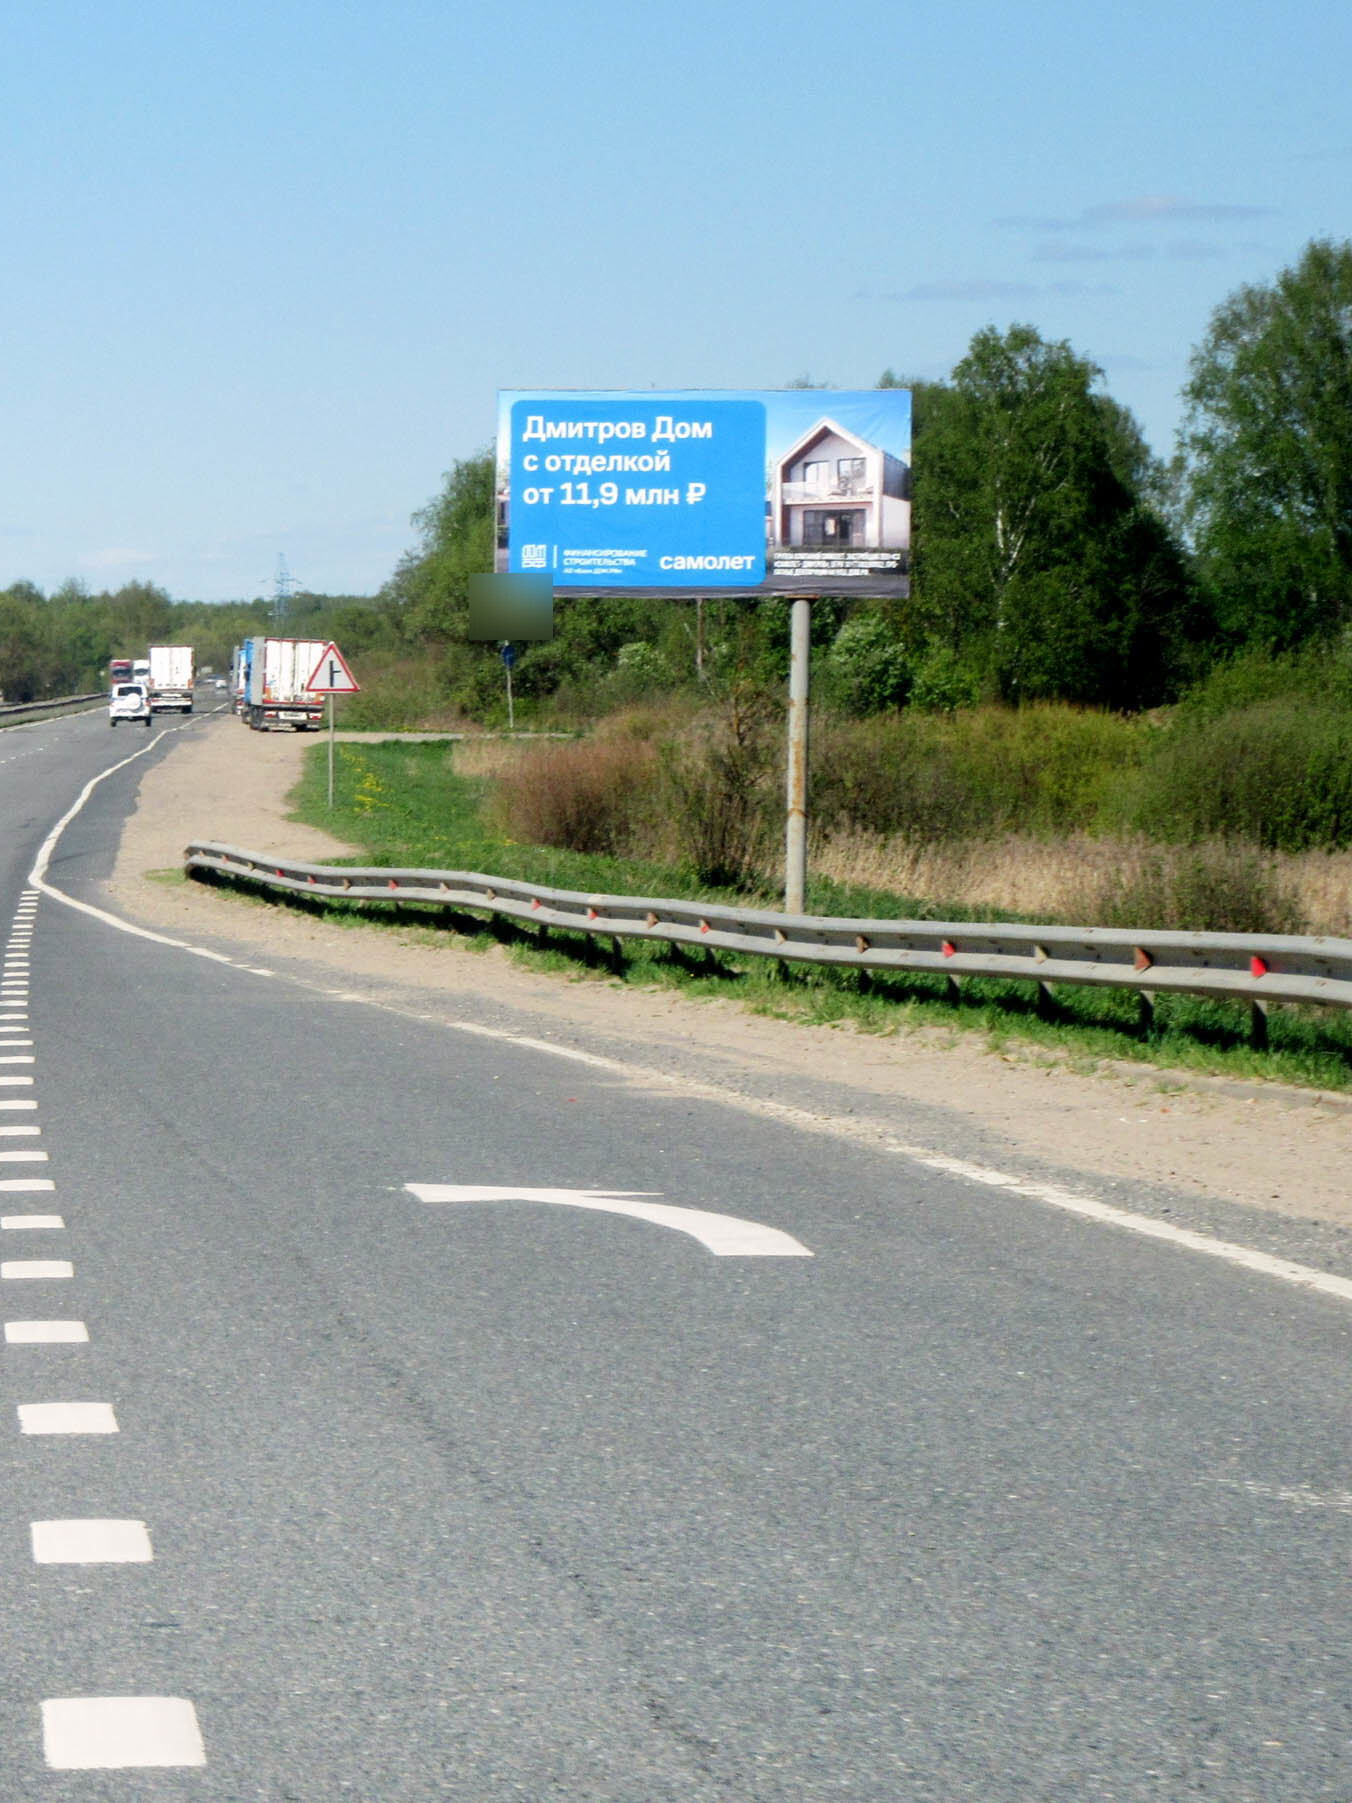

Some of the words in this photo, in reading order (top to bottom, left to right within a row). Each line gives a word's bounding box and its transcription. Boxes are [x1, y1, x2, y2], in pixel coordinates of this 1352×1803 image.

[522, 415, 646, 444] Дмитров
[651, 416, 713, 443] Дом
[523, 454, 539, 472] с
[544, 449, 671, 476] отделкой
[522, 487, 555, 505] от
[559, 482, 619, 509] 11,9
[625, 487, 680, 505] млн
[659, 555, 756, 571] самолет
